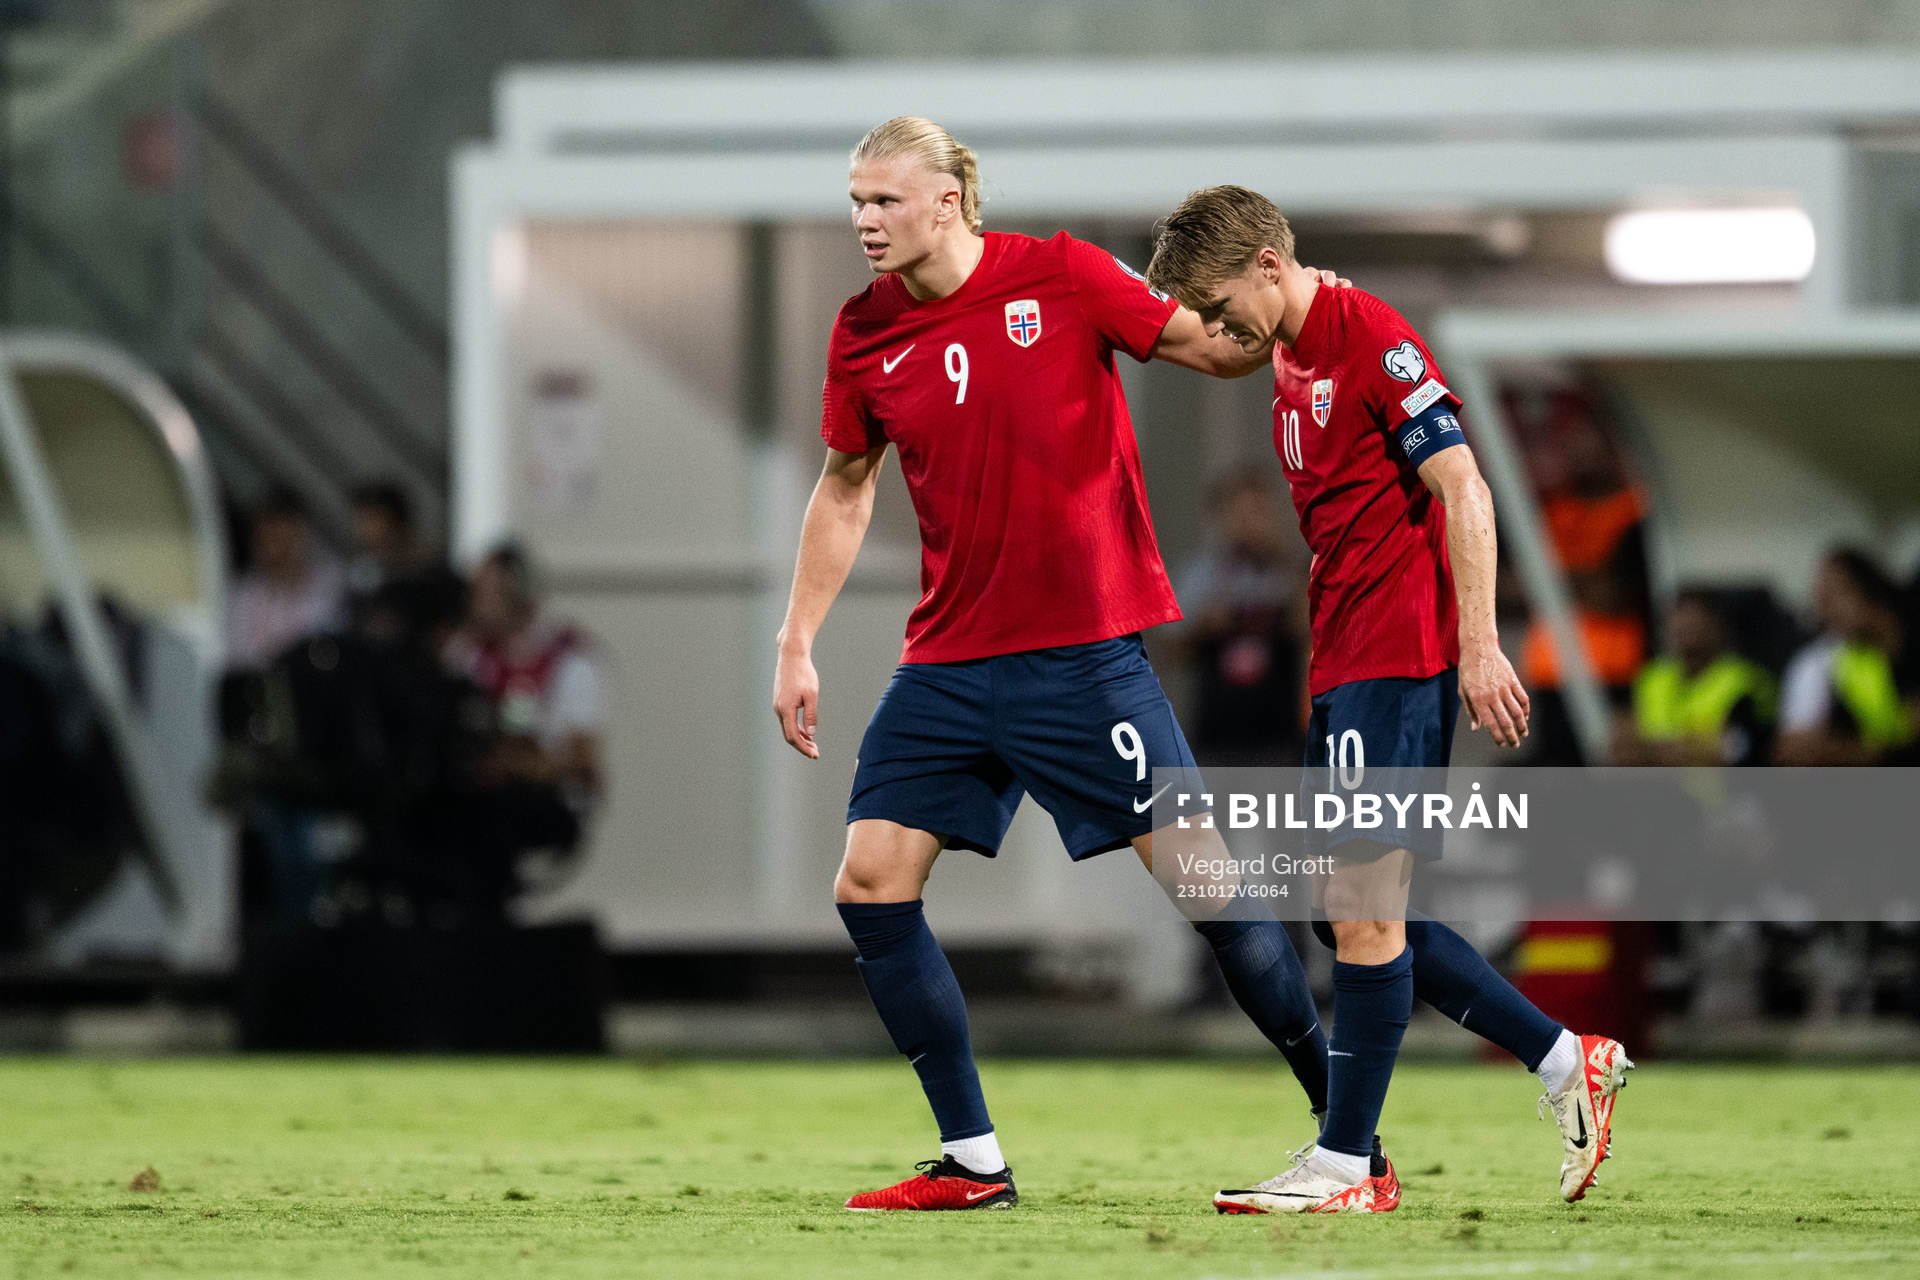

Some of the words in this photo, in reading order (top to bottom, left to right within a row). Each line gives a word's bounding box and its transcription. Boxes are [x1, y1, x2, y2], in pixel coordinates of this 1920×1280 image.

[944, 343, 969, 405] 9
[1282, 409, 1303, 470] 10
[1110, 721, 1147, 782] 9
[1325, 728, 1365, 793] 10
